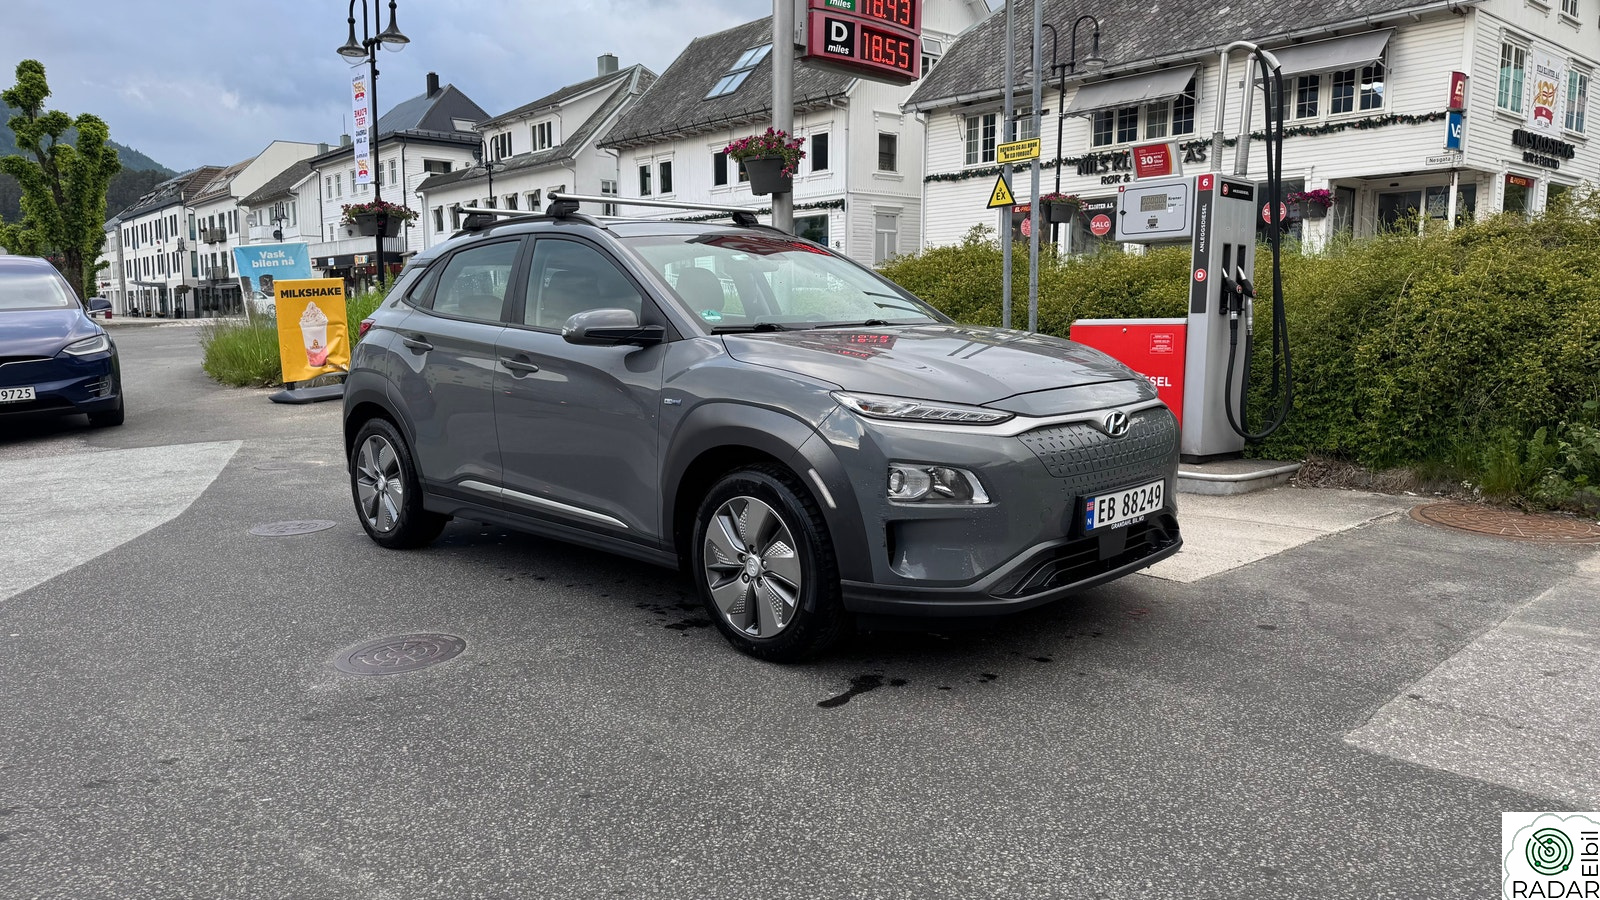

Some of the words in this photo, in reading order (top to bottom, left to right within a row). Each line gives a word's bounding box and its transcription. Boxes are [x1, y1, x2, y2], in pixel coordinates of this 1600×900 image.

[831, 21, 848, 42] D
[828, 44, 850, 55] miles
[863, 33, 909, 69] 18.55
[1077, 155, 1109, 175] NILS
[1183, 147, 1207, 163] AS
[1140, 156, 1154, 166] 30
[1101, 174, 1120, 185] RØR
[1123, 173, 1131, 182] &
[1202, 178, 1208, 186] 6
[996, 191, 1006, 200] EX
[1091, 220, 1110, 228] SALG
[1200, 203, 1208, 253] ANLEGGSDIESEL
[259, 250, 286, 259] Vask
[251, 258, 279, 268] bilen
[281, 256, 295, 267] nå
[280, 287, 342, 299] MILKSHAKE
[1145, 376, 1172, 387] SEL
[0, 388, 31, 400] 9725
[1098, 497, 1116, 523] EB
[1122, 484, 1161, 517] 88249
